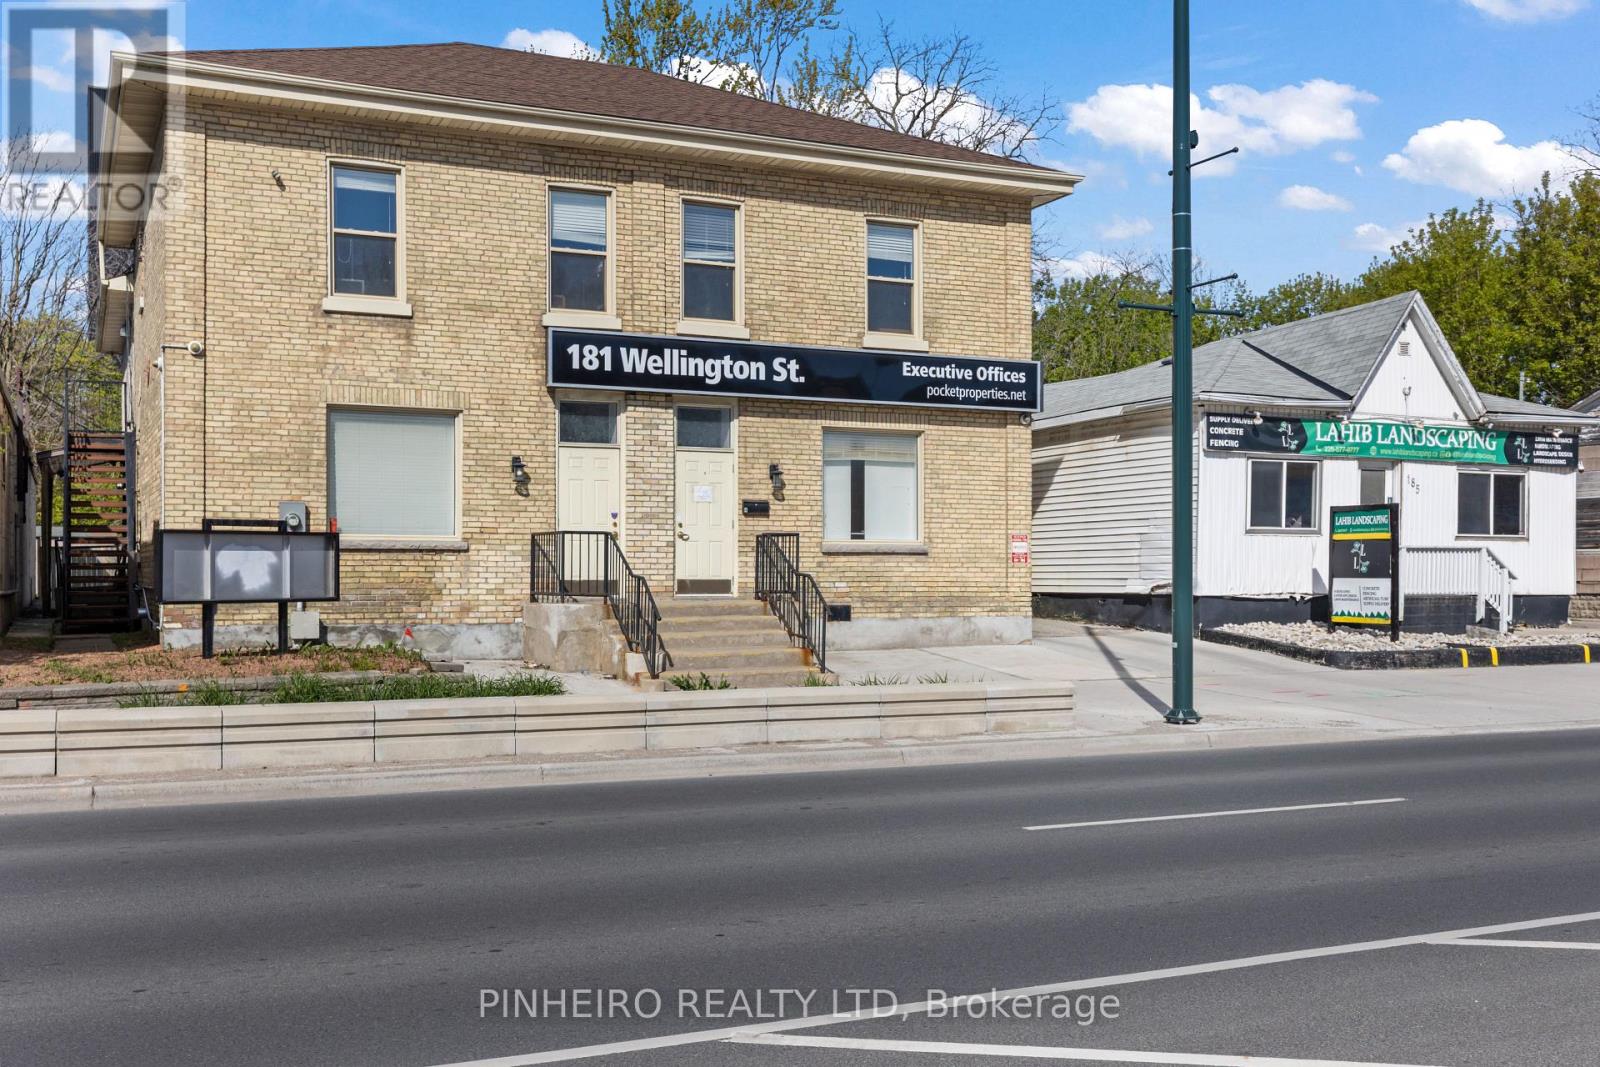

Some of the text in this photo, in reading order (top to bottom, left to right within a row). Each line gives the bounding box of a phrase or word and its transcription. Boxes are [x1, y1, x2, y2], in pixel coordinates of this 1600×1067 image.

[566, 343, 806, 386] 181 Wellington St.
[902, 361, 1027, 385] Executive Offices
[926, 383, 1027, 404] pocketproperties.net
[1209, 427, 1244, 436] CONCRETE
[1315, 422, 1497, 451] LAHIB LANDSCAPING
[1209, 439, 1240, 448] FENCING
[1335, 514, 1389, 526] LAHIB LANDSCAPING
